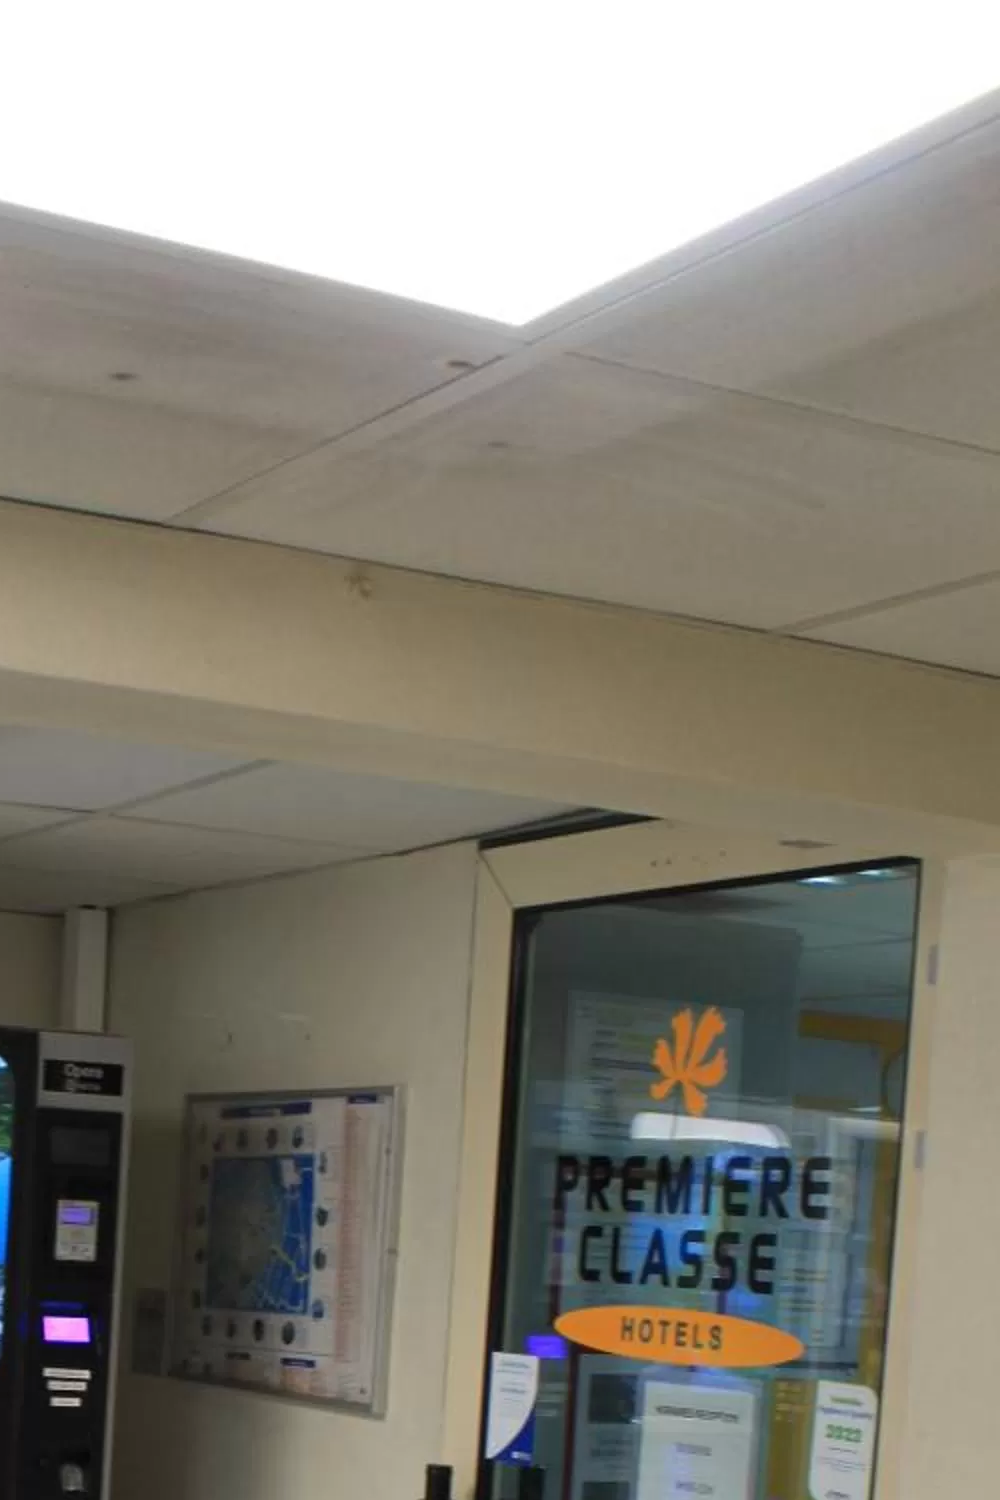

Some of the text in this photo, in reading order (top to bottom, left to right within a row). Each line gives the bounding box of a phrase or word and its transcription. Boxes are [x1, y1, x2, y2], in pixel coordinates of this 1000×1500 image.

[553, 1154, 833, 1221] PREMIERE
[578, 1224, 778, 1295] CLASSE
[620, 1315, 724, 1352] HOTELS
